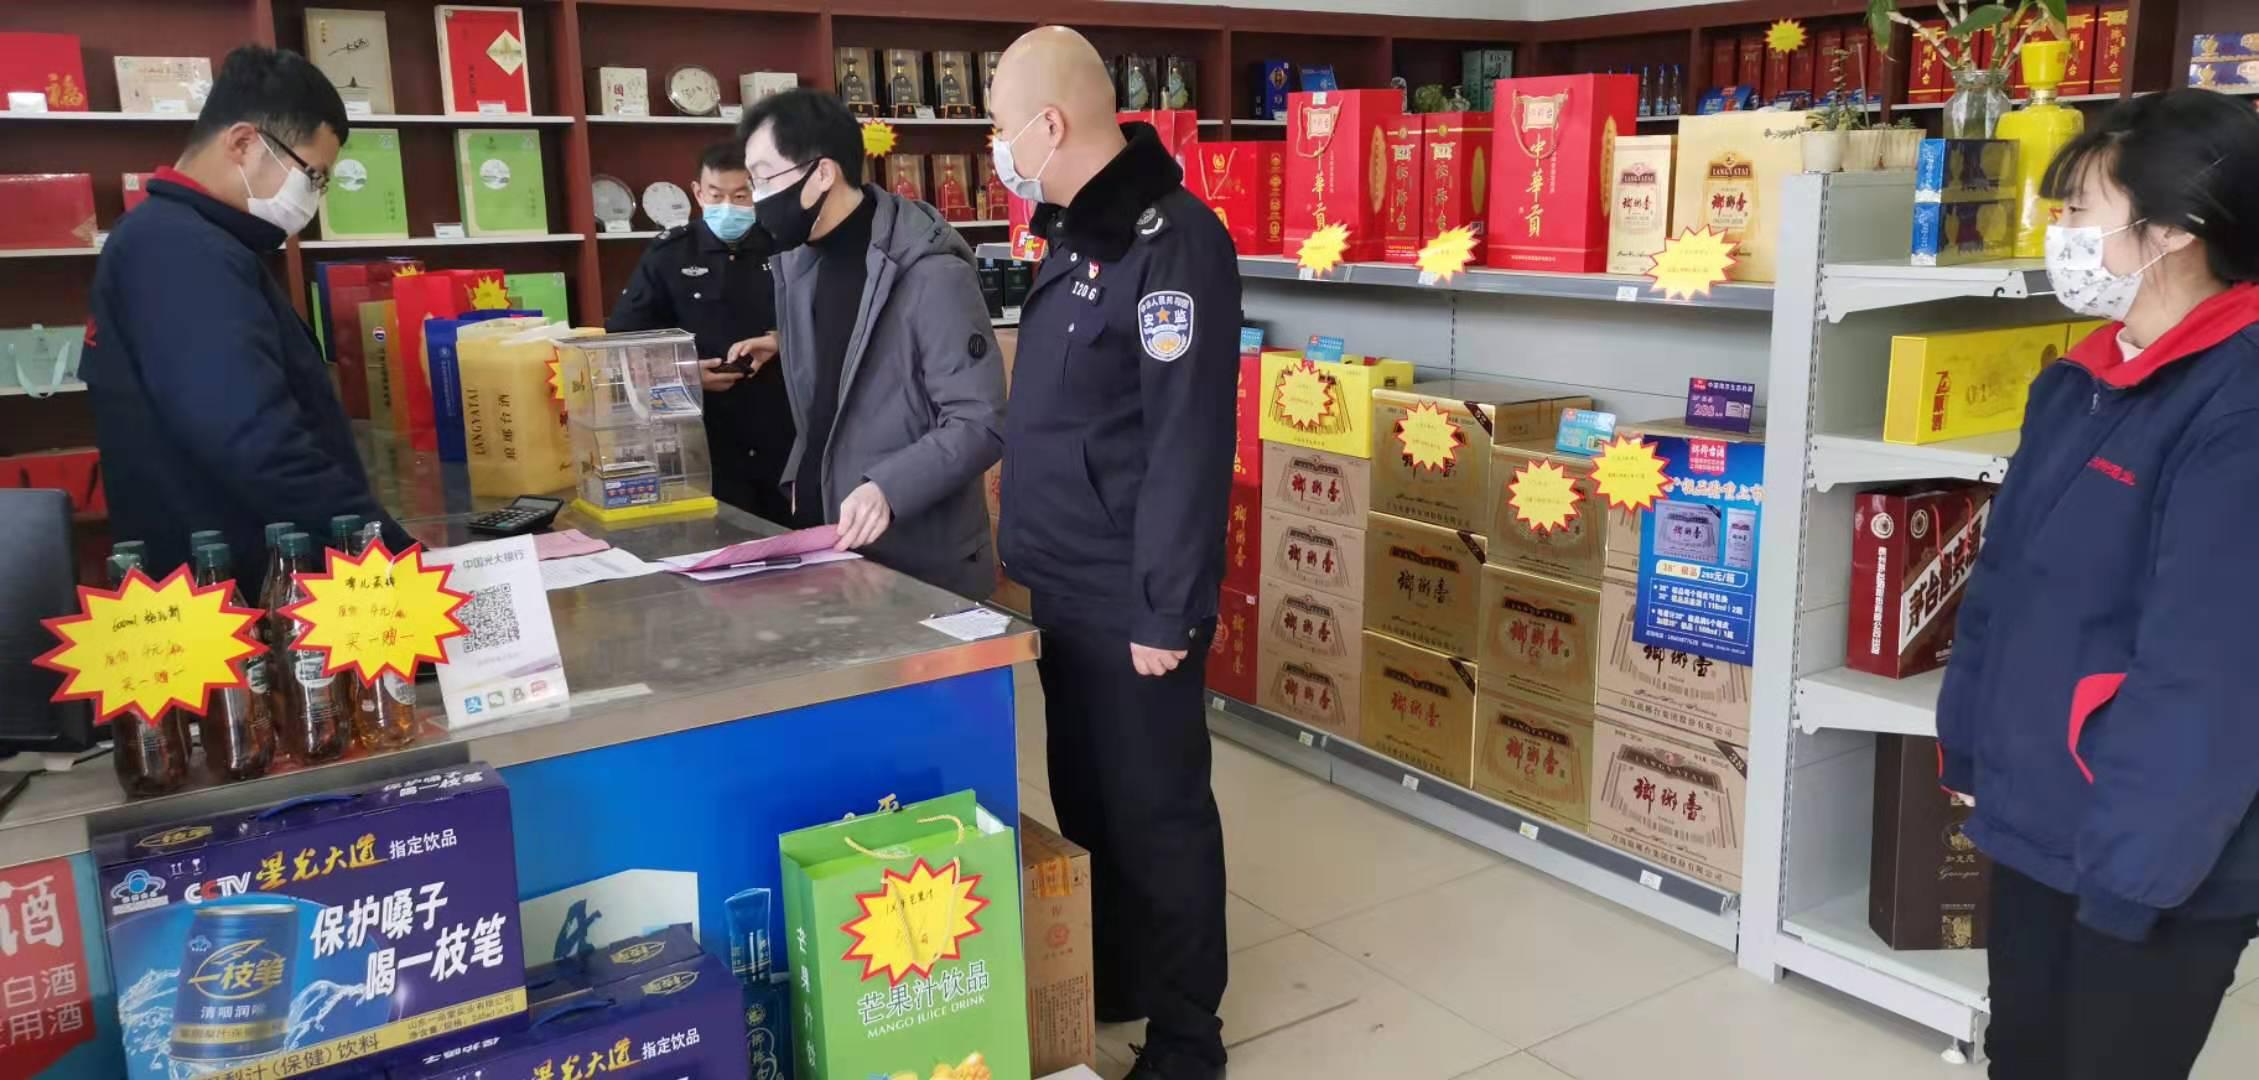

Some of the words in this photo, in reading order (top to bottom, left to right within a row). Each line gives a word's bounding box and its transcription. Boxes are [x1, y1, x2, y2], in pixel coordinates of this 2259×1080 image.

[462, 550, 524, 570] 中国光大银行
[184, 872, 251, 904] CCTV
[388, 828, 458, 861] 指定饮品
[309, 881, 449, 961] 保护嗓子
[187, 956, 287, 991] 一枝笔
[362, 912, 507, 1001] 喝一枝笔
[3, 963, 78, 1009] 白酒
[857, 959, 989, 1026] 芒果汁饮品
[867, 1016, 914, 1039] MANGO
[951, 995, 985, 1013] DRINK
[641, 1027, 701, 1061] 指定饮品
